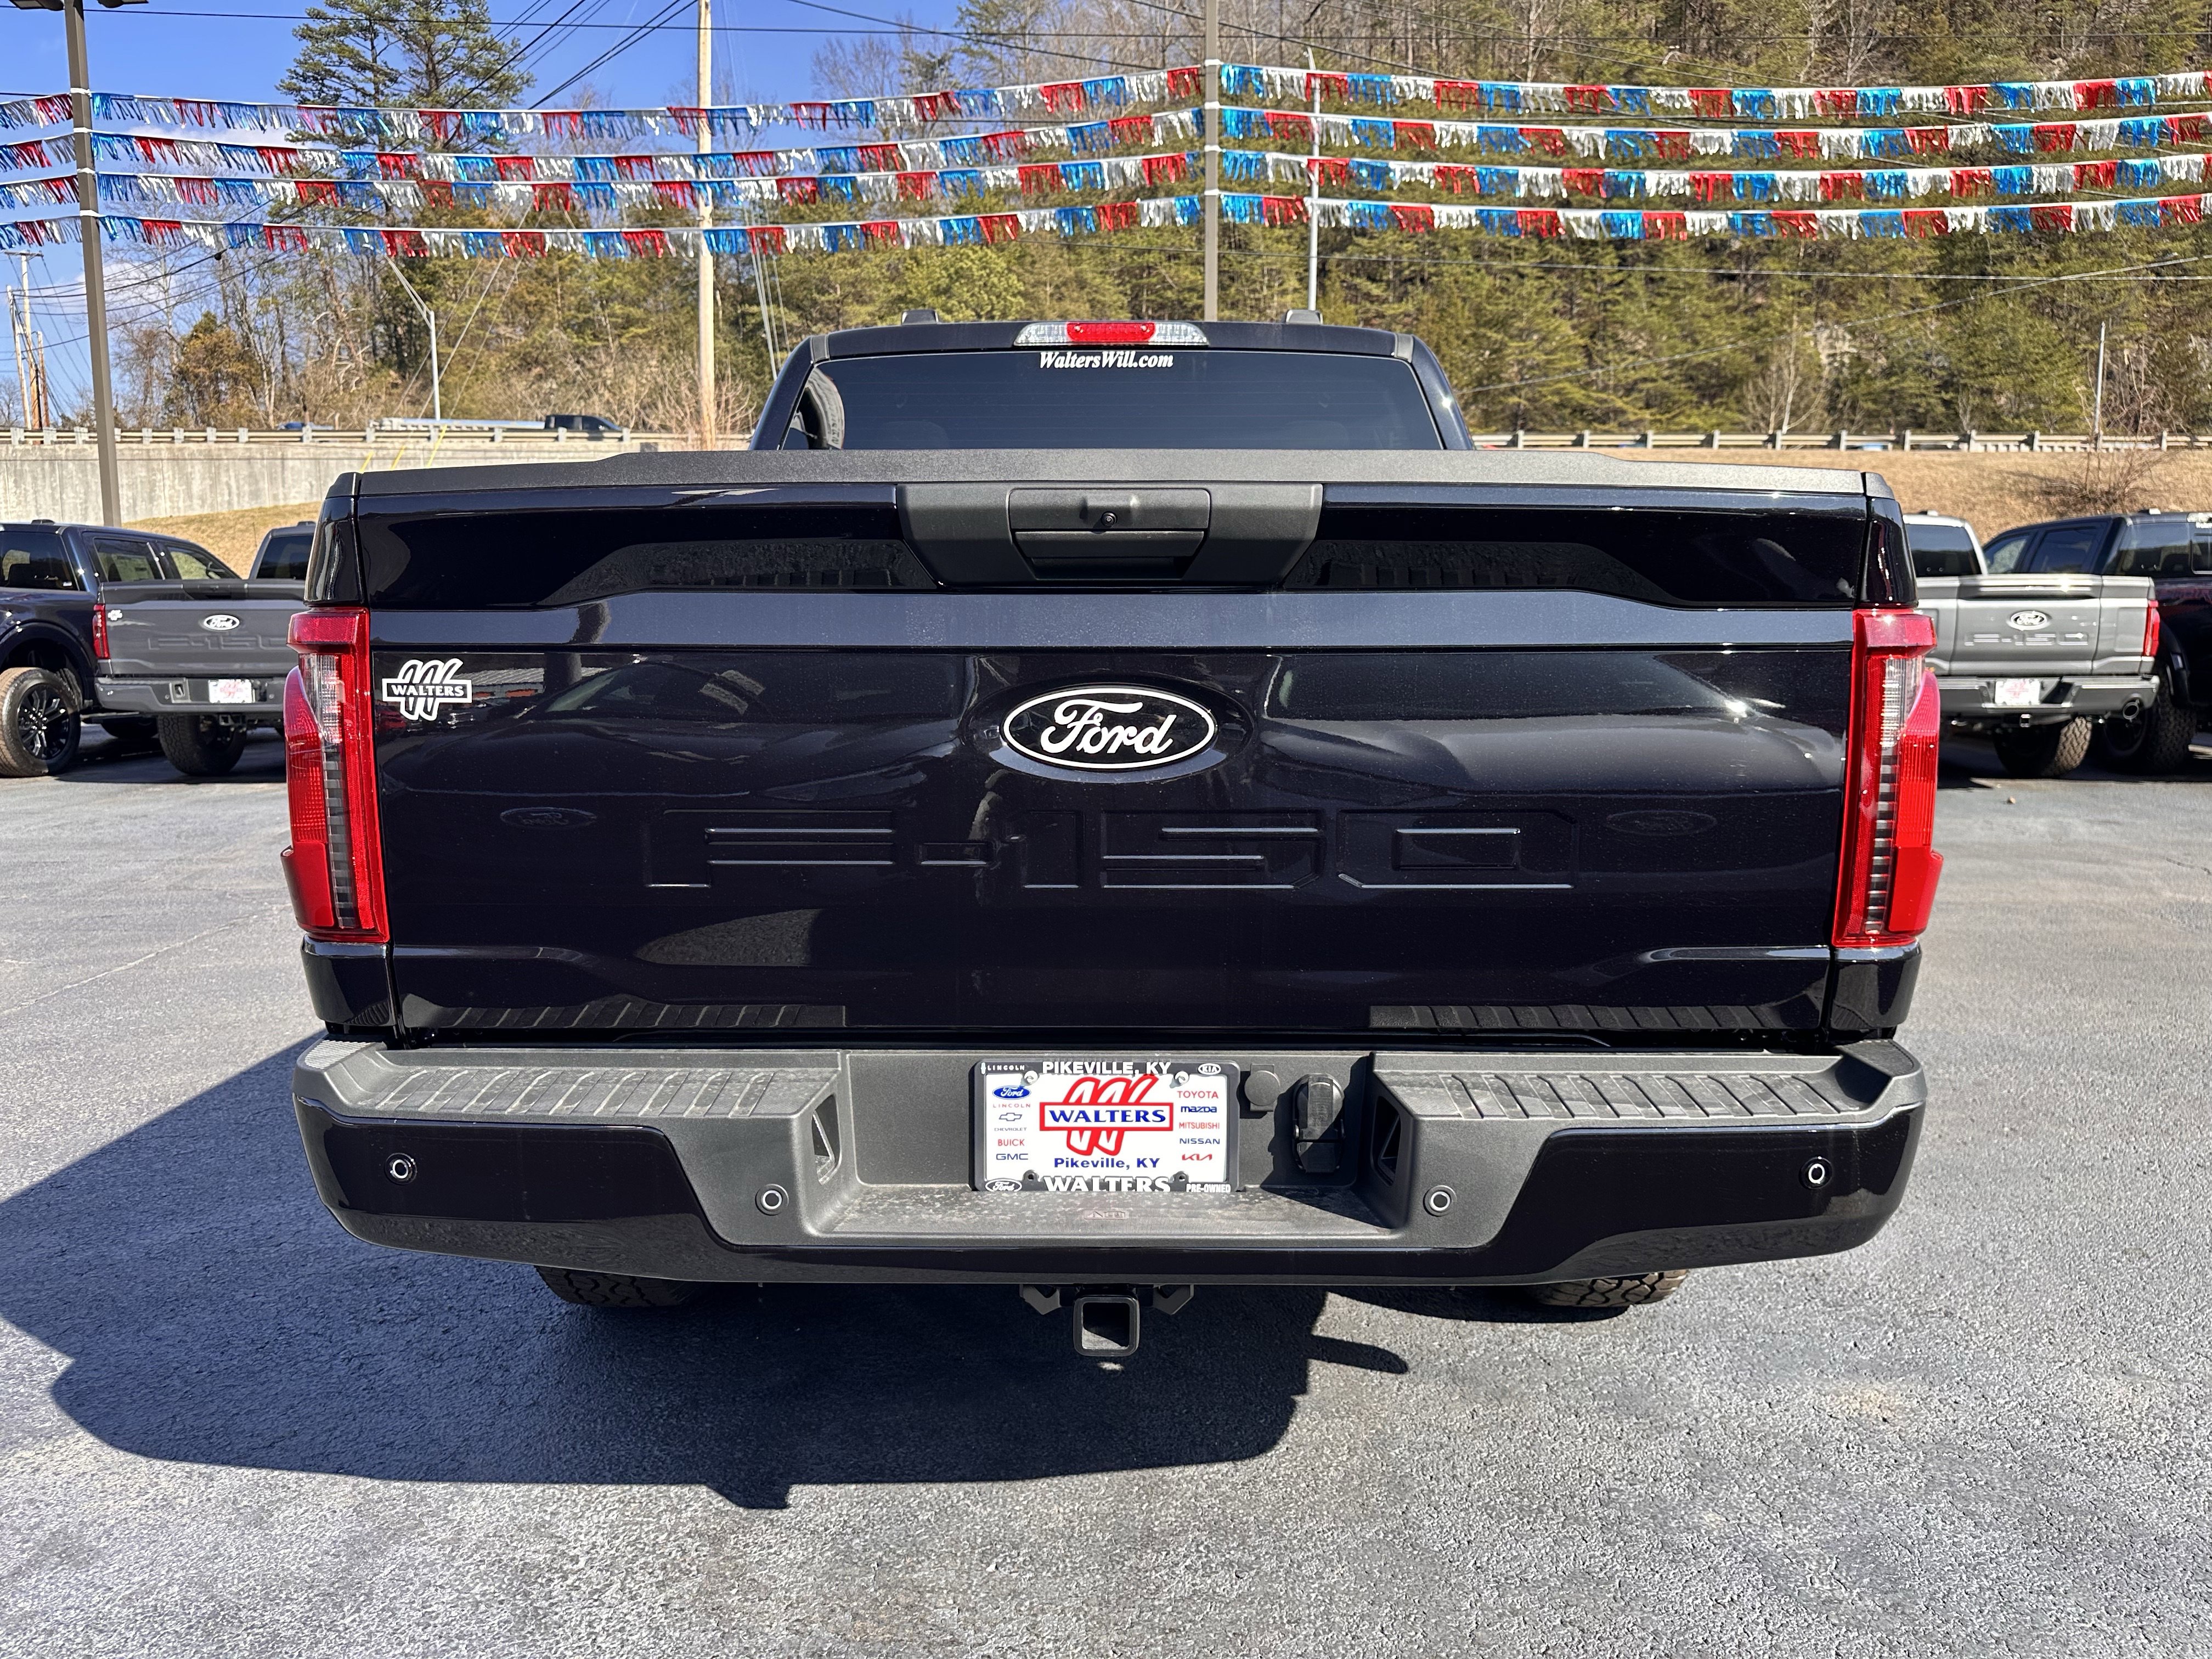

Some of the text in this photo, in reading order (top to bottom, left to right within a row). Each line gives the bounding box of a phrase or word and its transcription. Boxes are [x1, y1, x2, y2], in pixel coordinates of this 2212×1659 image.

[1040, 351, 1173, 369] WaltersWill.com
[210, 618, 233, 628] Ford
[2017, 613, 2044, 625] Ford
[391, 685, 464, 697] WALTERS
[1040, 699, 1177, 754] Ford
[644, 809, 1579, 889] F-150
[1042, 1061, 1171, 1076] PIKEVILLE, KY
[1000, 1087, 1024, 1097] Ford
[1177, 1091, 1218, 1099] TOYOTA
[1048, 1109, 1166, 1123] WALTERS
[1054, 1157, 1160, 1170] Pikeville, KY
[992, 1181, 1015, 1191] Ford
[1043, 1177, 1171, 1192] WALTERS
[1186, 1183, 1231, 1192] PRE-OWNED
